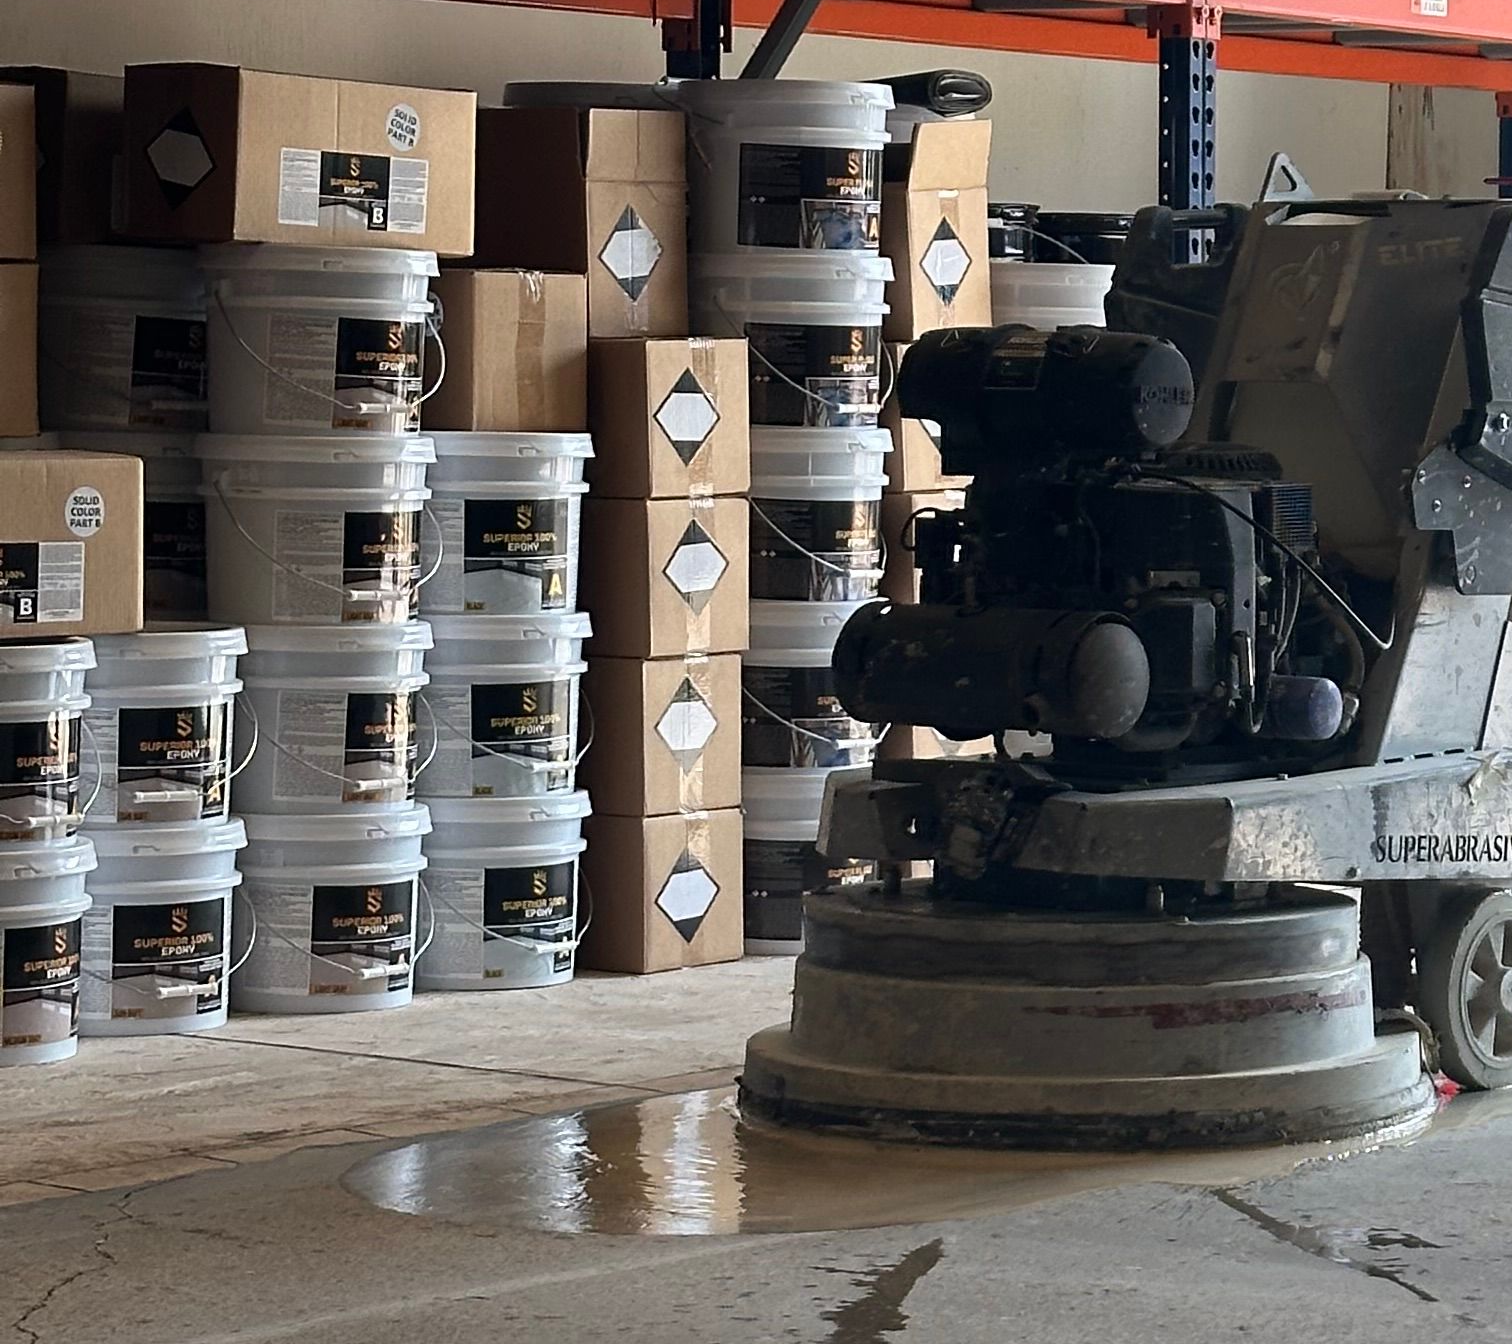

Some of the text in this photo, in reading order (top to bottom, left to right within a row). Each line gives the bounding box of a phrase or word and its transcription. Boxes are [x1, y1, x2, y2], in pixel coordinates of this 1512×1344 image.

[395, 109, 417, 125] SOLID
[390, 119, 416, 137] COLOR
[388, 128, 407, 143] PART
[373, 207, 384, 224] B
[869, 217, 878, 238] A
[73, 496, 100, 505] SOLID
[71, 507, 101, 517] COLOR
[70, 519, 93, 528] PART
[483, 533, 532, 543] SUPERIOR
[507, 542, 540, 552] EPOXY
[548, 573, 563, 596] A
[20, 598, 32, 615] B
[140, 741, 193, 752] SUPERIOR
[166, 750, 200, 760] EPOXY
[502, 899, 547, 911] SUPERIOR
[332, 916, 382, 928] SUPERIOR
[134, 932, 214, 949] SUPERIOR 100%
[161, 944, 196, 956] EPOXY
